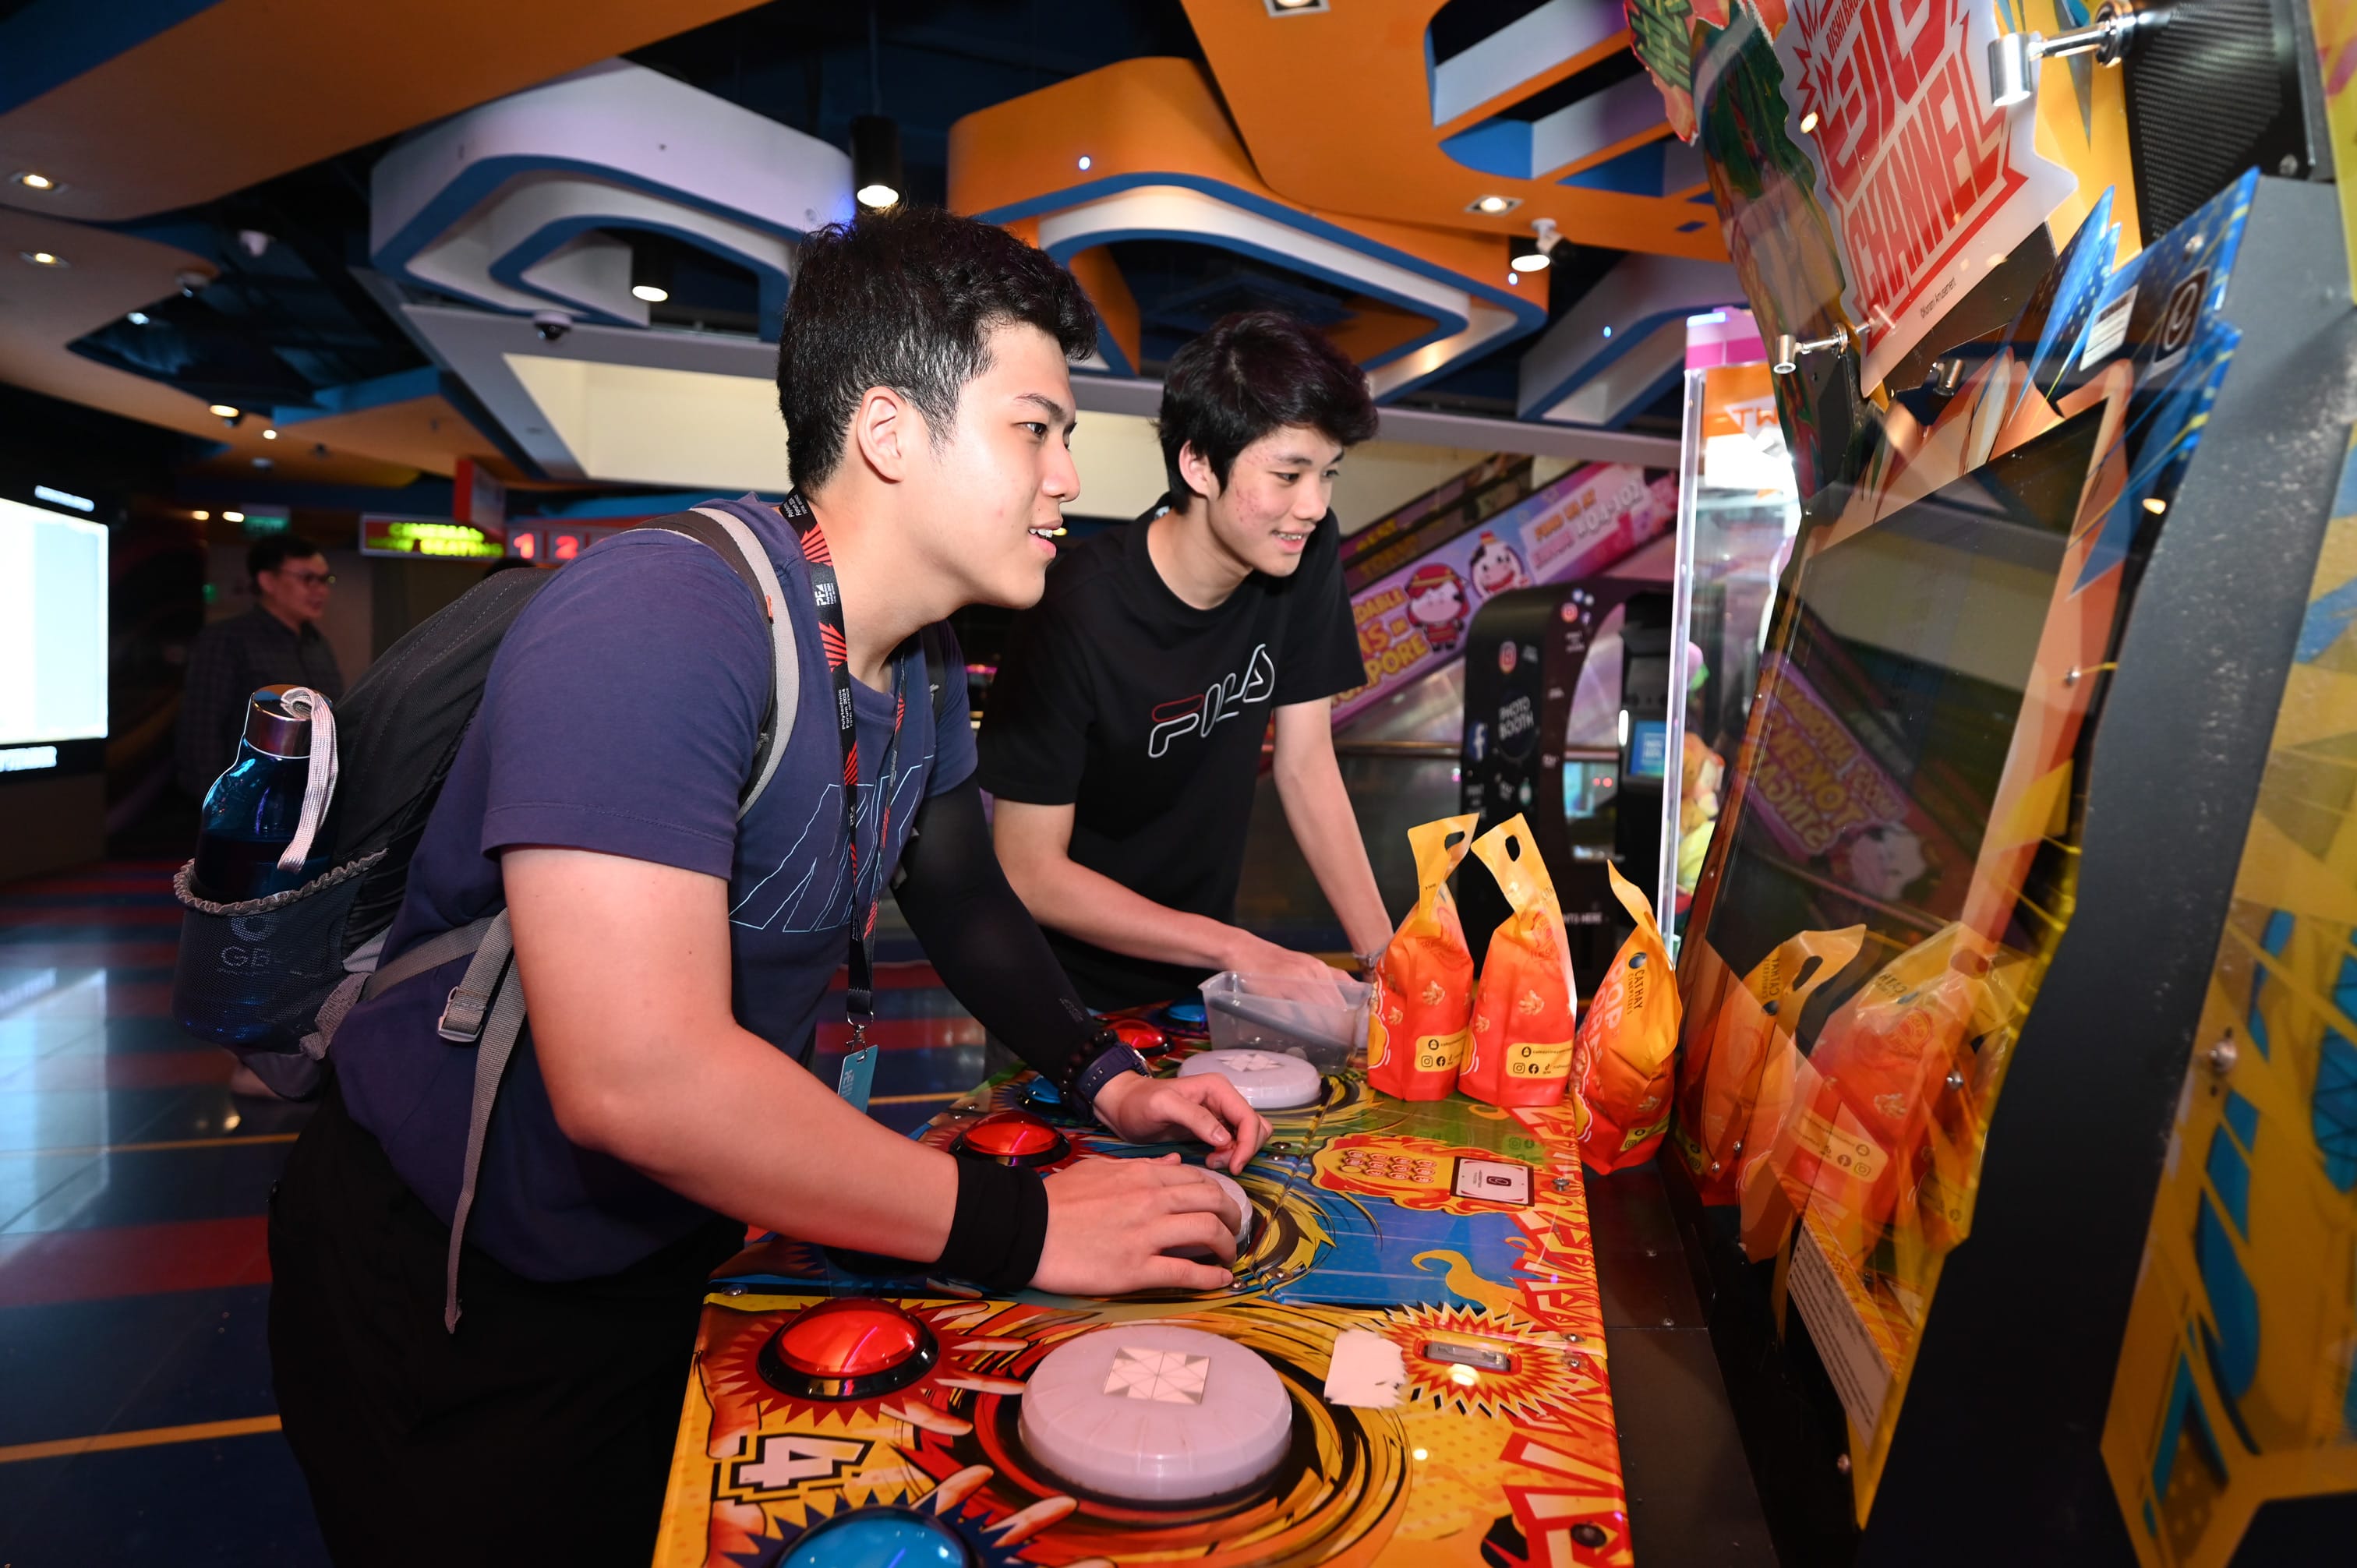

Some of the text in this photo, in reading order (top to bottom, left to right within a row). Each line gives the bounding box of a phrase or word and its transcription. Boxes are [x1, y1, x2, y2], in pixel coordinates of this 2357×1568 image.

[1826, 4, 1846, 61] BISHI
[1847, 51, 2002, 310] CHANNEL
[513, 533, 534, 559] 1
[555, 535, 578, 559] 2
[1148, 643, 1275, 758] FILA
[1604, 957, 1627, 1030] POP
[1634, 969, 1645, 1010] CATHAY
[737, 1434, 865, 1490] 4
